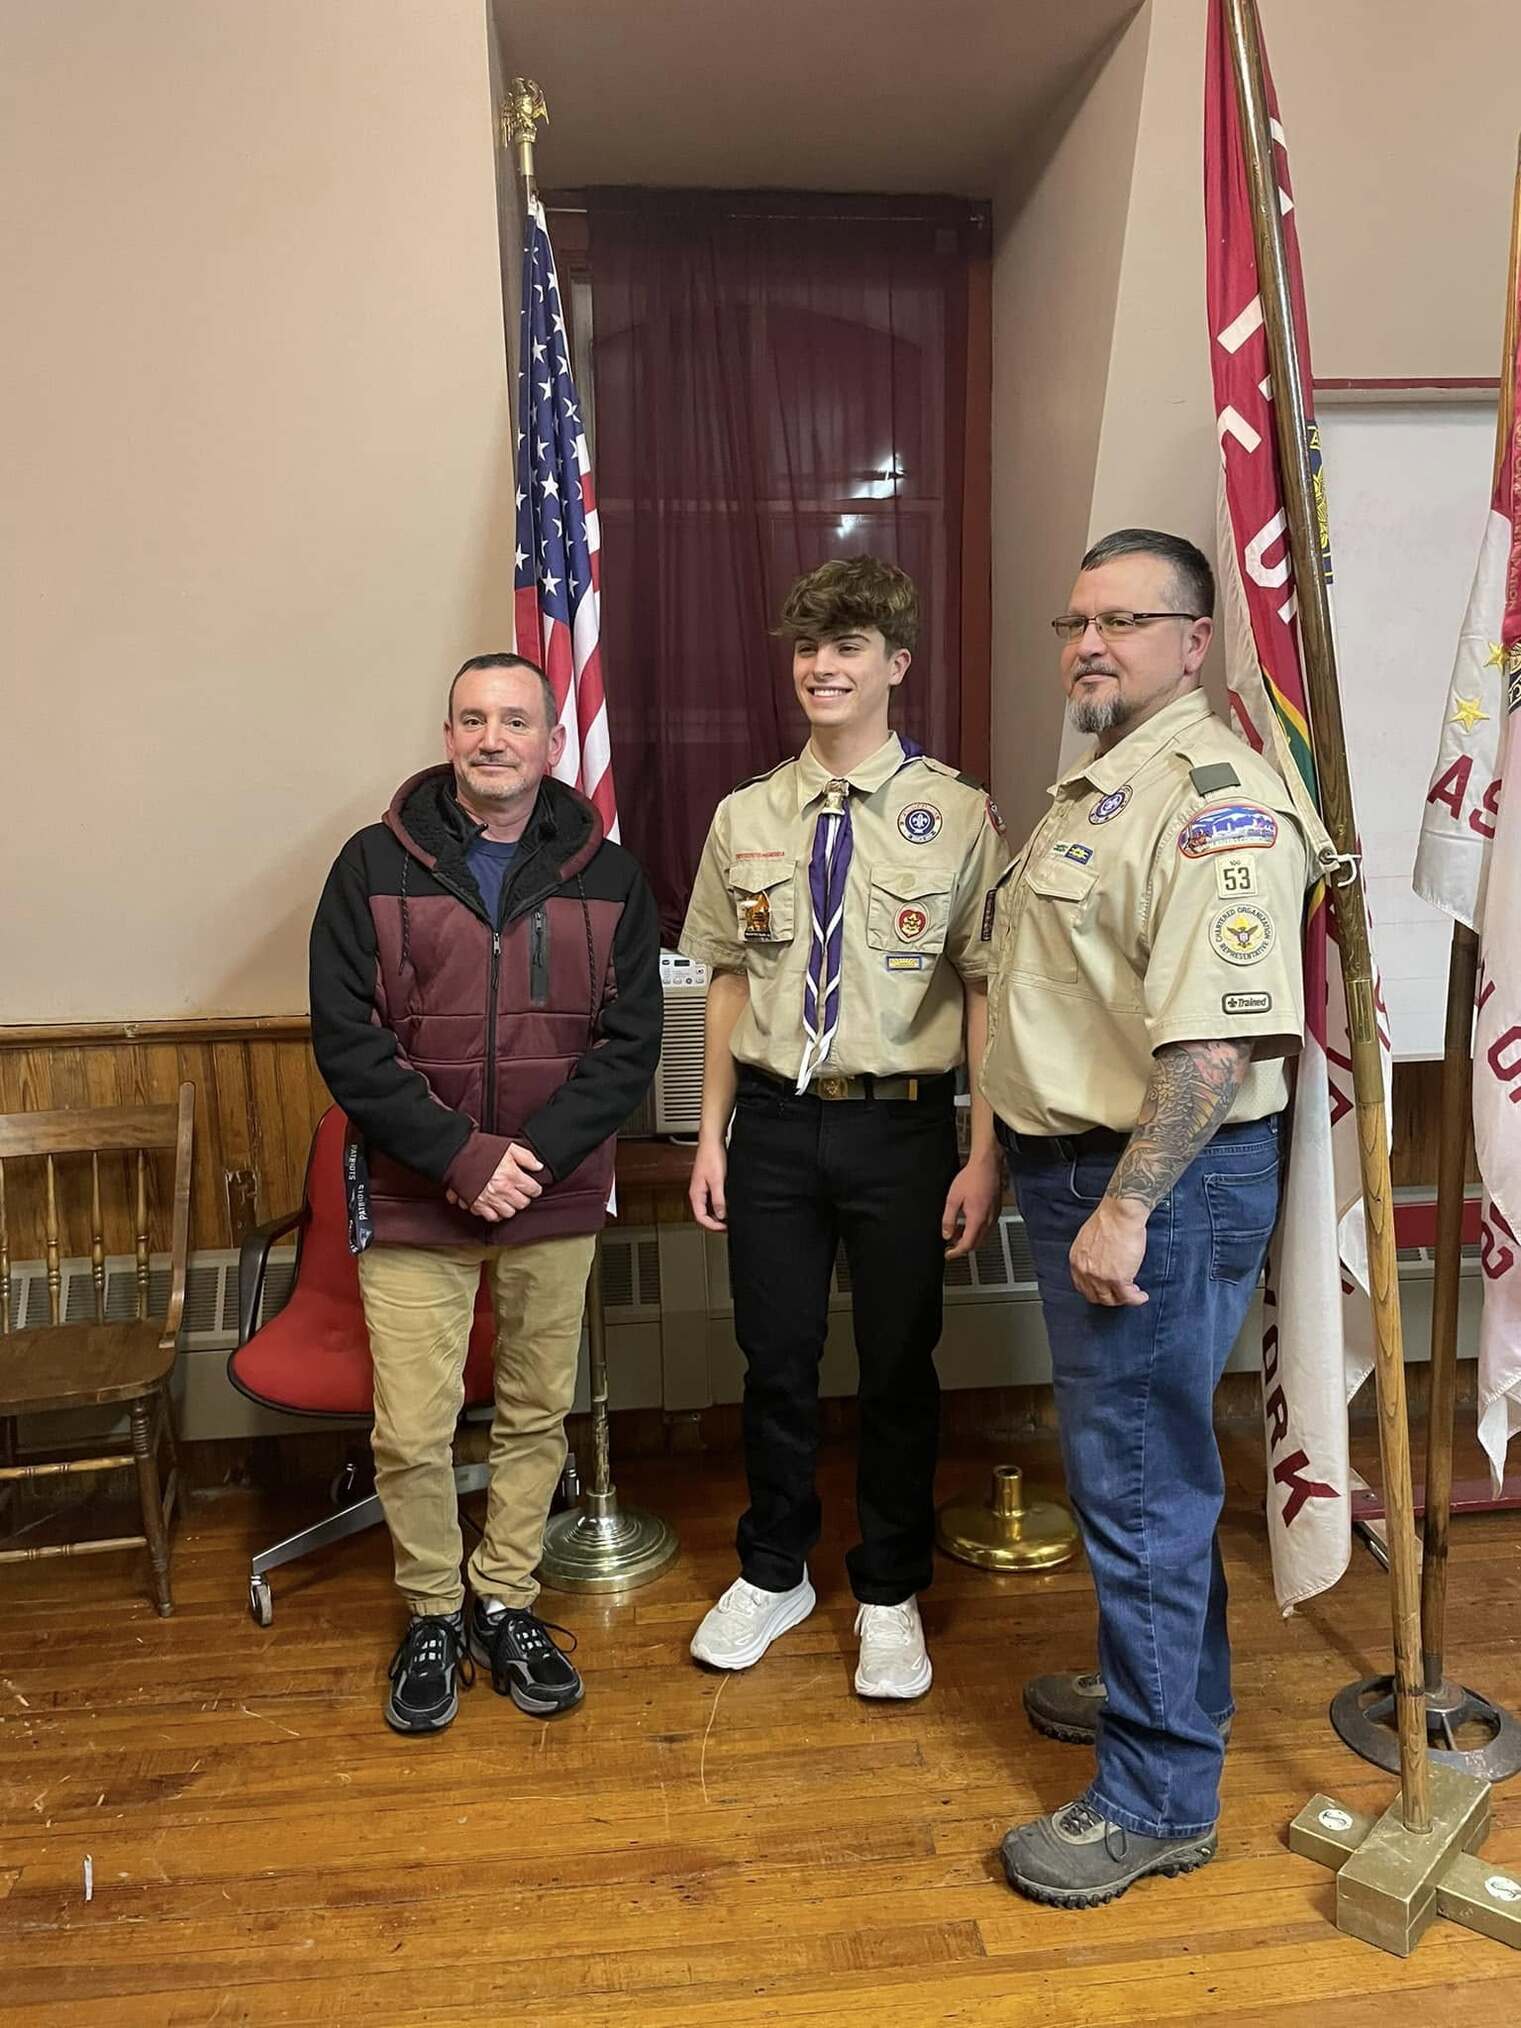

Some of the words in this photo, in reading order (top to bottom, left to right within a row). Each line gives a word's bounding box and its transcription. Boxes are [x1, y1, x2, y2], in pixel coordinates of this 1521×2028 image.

[1223, 867, 1251, 890] 53
[1215, 909, 1236, 943] CHARTERED
[1236, 906, 1271, 939] ORGANIZATION
[1219, 941, 1269, 961] REPRESENTATIVE
[1237, 996, 1267, 1007] Trained
[348, 1144, 358, 1180] PATRIOTS
